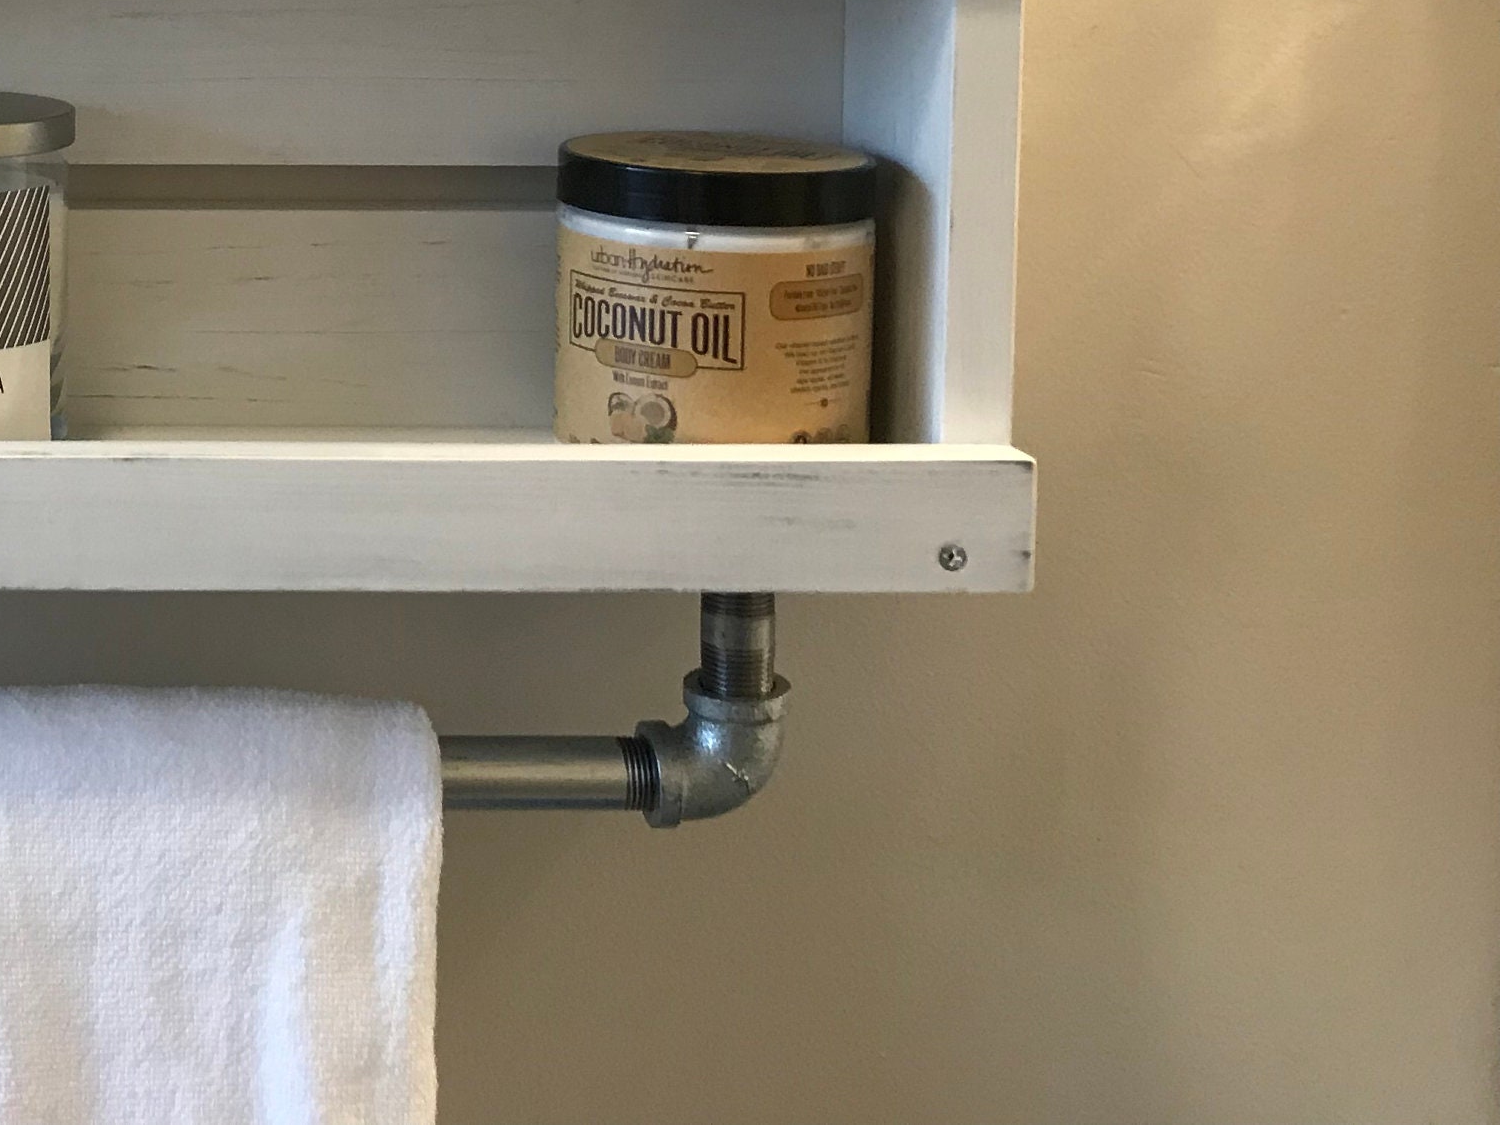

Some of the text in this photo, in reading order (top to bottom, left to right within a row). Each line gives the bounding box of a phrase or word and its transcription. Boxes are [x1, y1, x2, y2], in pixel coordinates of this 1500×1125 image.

[573, 292, 738, 364] COCONUT OIL
[614, 344, 671, 370] BODY CREAM
